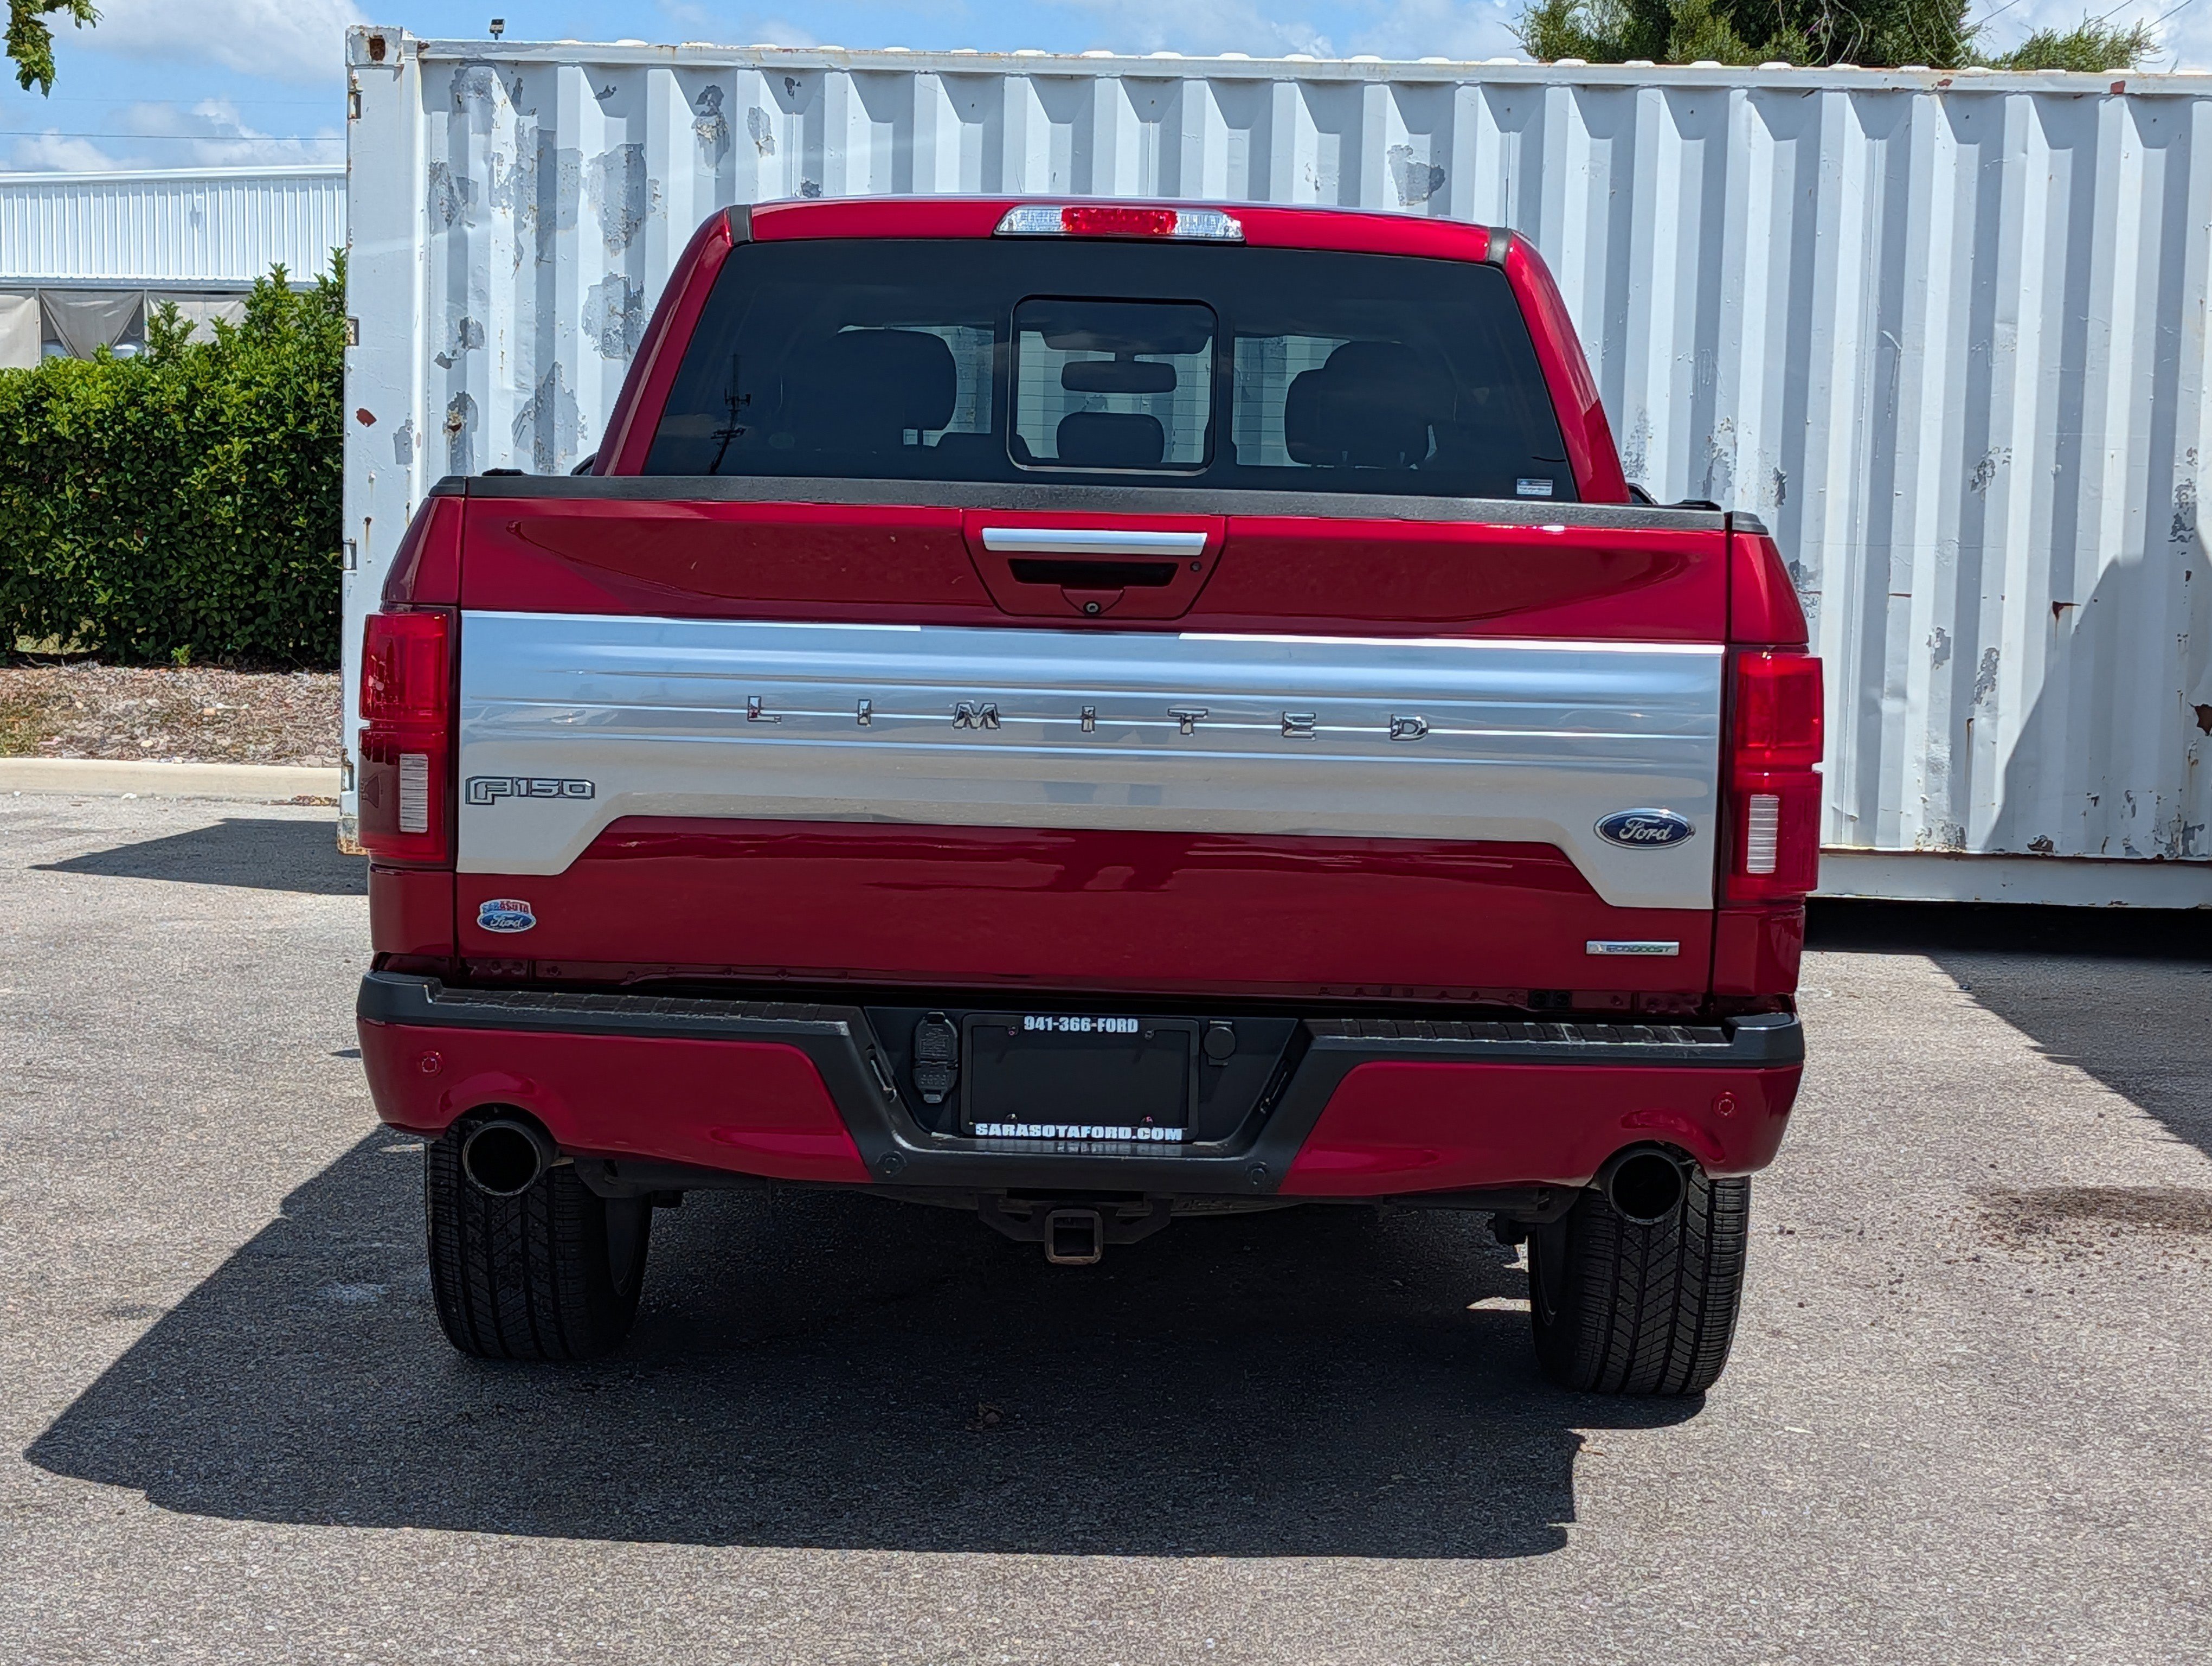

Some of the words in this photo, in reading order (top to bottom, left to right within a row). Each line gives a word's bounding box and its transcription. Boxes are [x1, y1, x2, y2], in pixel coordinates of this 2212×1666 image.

[747, 695, 1429, 741] LIMITED
[1619, 817, 1674, 840] Ford
[490, 914, 523, 928] Ford
[1024, 1015, 1139, 1033] 941-366-FORD
[975, 1123, 1182, 1141] SARASOTAFORD.COM
